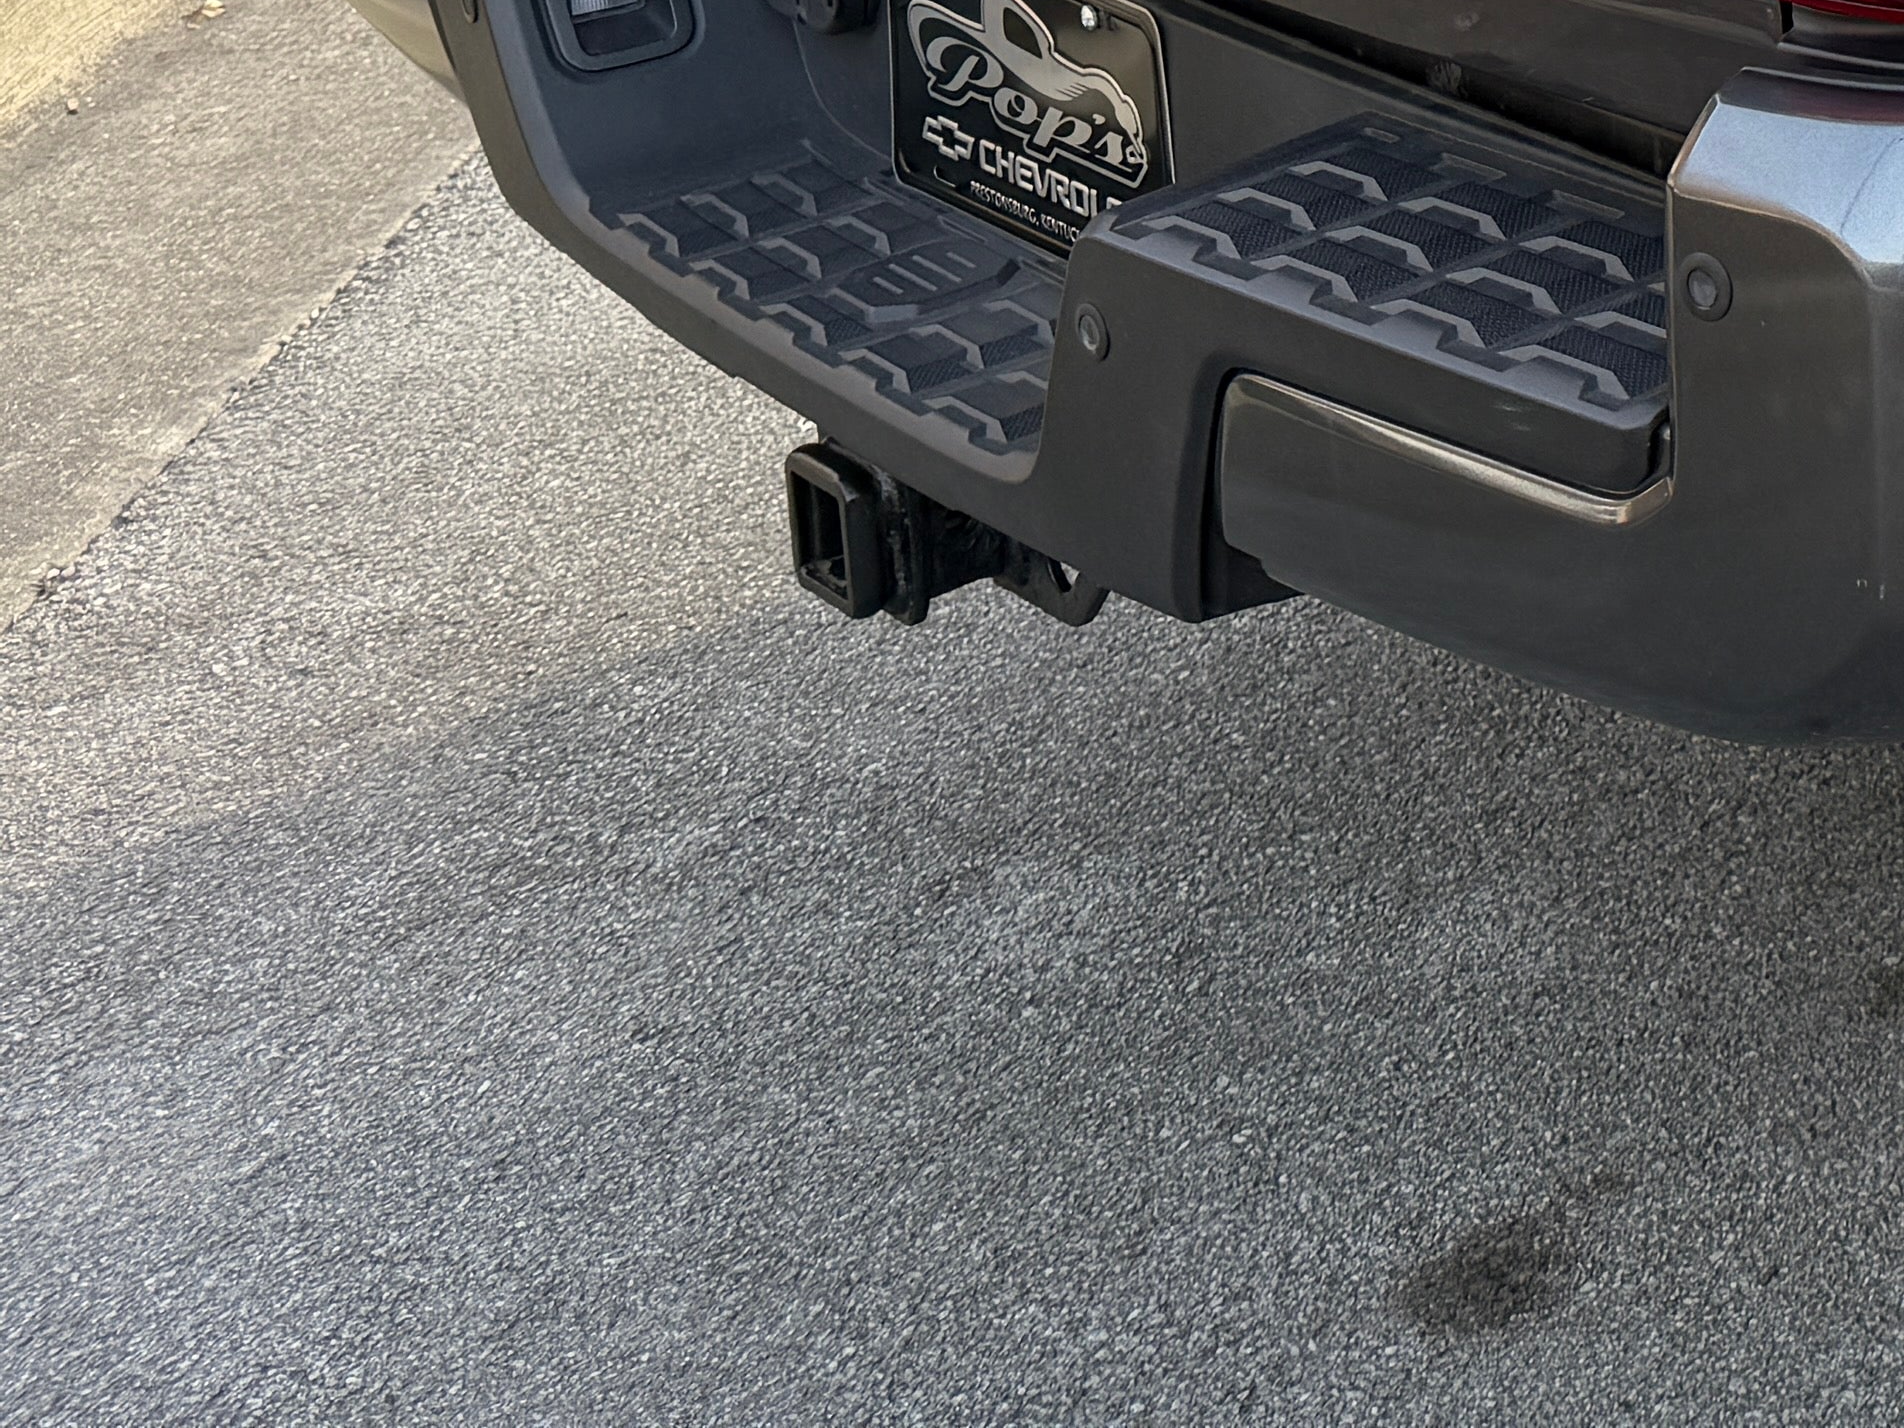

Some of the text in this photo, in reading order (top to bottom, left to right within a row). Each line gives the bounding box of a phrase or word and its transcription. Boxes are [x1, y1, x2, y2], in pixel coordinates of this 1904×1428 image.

[925, 35, 1126, 168] Pop's
[979, 138, 1123, 218] CHEVROL
[1040, 212, 1081, 243] KENTUC
